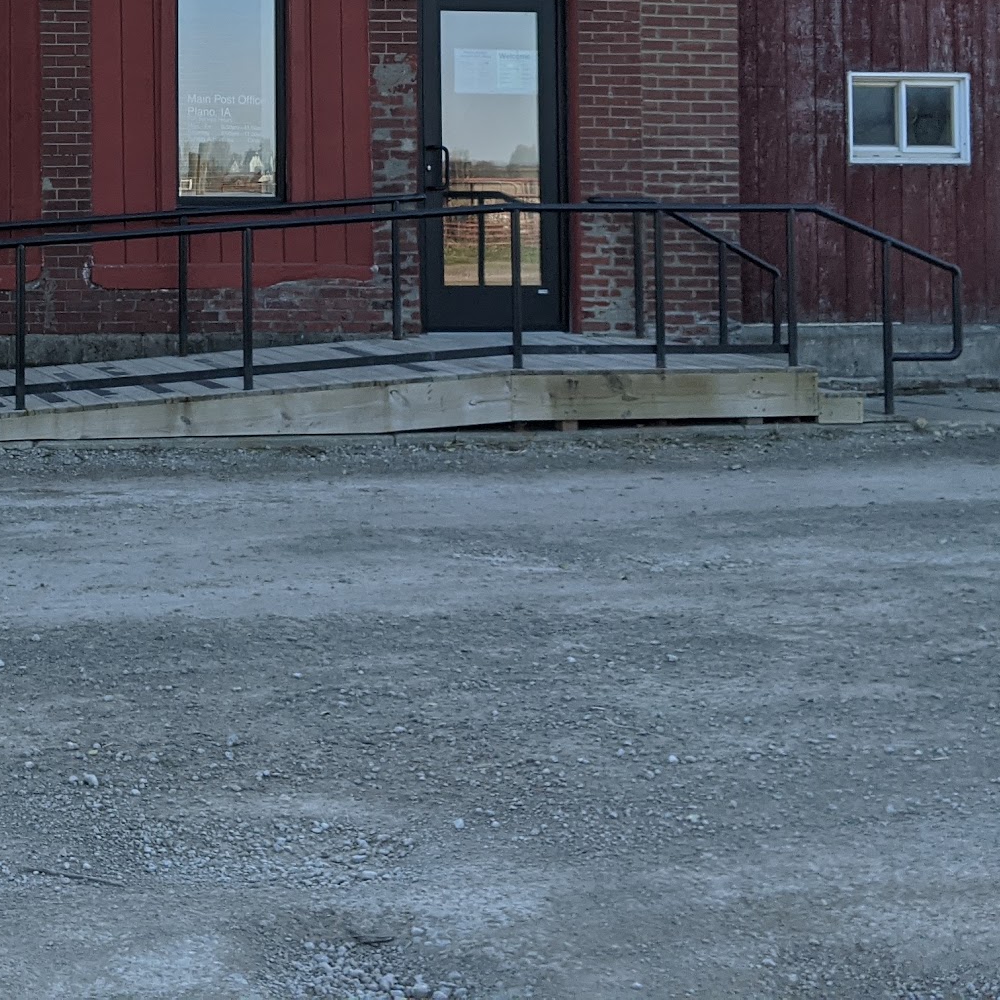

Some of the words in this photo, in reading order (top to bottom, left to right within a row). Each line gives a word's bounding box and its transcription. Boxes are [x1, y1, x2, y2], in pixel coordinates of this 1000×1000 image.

[187, 93, 211, 104] Main
[214, 94, 235, 105] Post
[221, 107, 232, 117] IA
